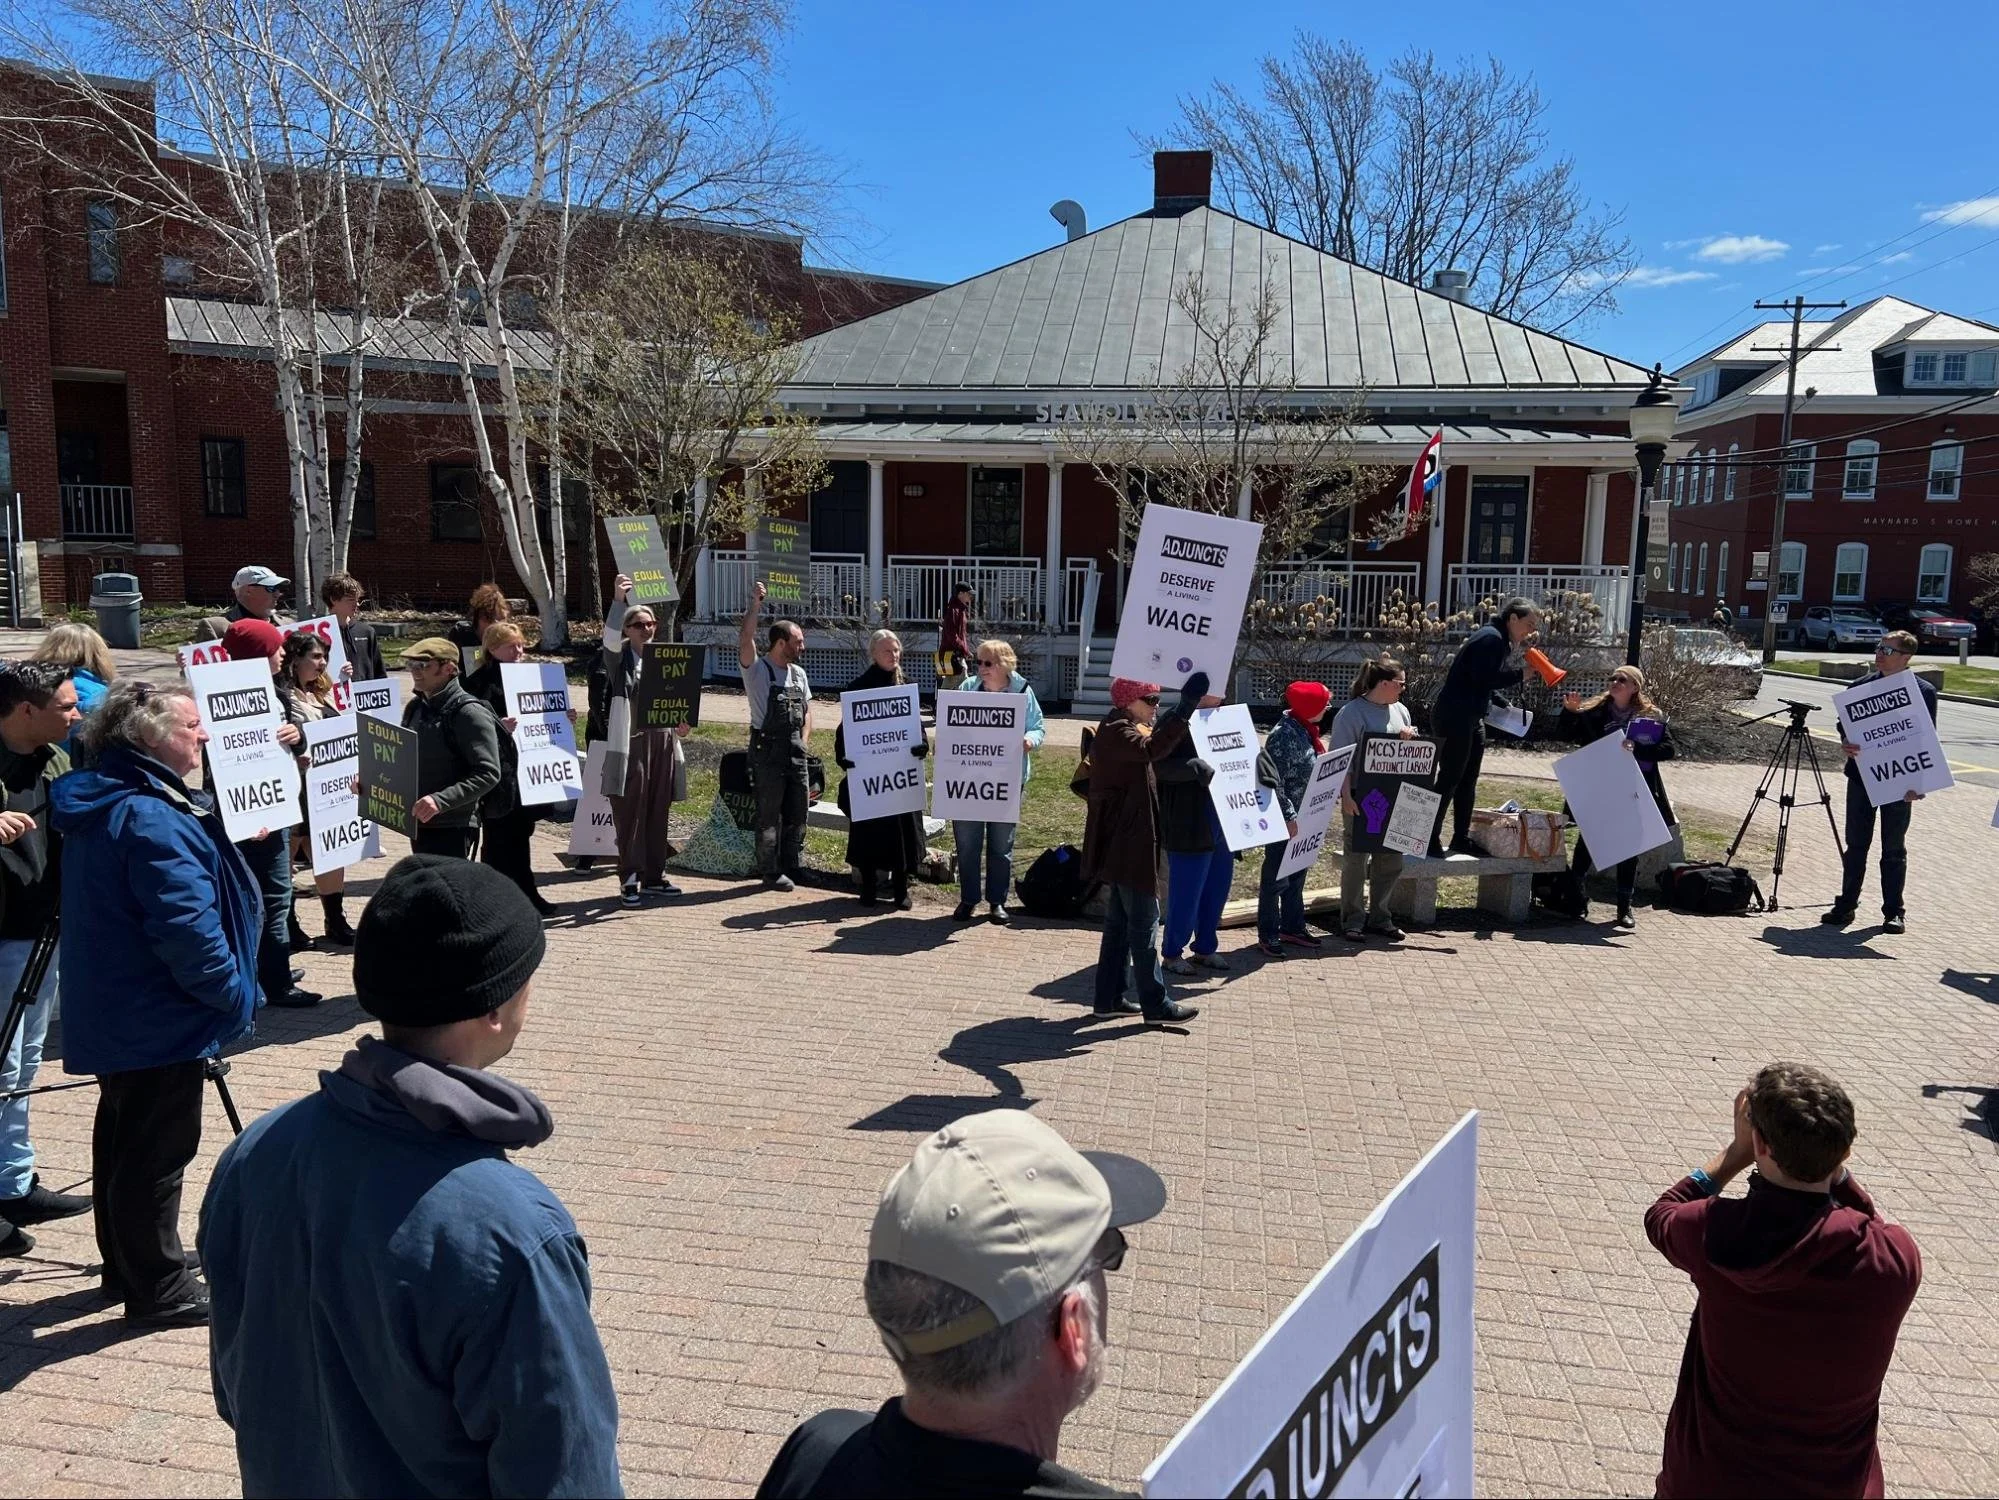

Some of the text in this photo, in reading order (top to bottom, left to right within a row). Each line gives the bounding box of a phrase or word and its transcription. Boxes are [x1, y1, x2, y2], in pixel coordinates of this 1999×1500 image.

[618, 521, 649, 533] EQUAL
[769, 522, 799, 536] EQUAL
[628, 534, 649, 555] PAY
[773, 538, 793, 553] PAY
[1161, 538, 1227, 566] ADJUNCTS
[633, 569, 665, 582] EQUAL
[769, 571, 800, 585] EQUAL
[1160, 571, 1215, 592] DESERVE
[635, 581, 671, 599] WORK
[767, 583, 801, 601] WORK
[1174, 591, 1200, 601] LIVING
[1147, 605, 1212, 636] WAGE
[654, 647, 691, 659] EQUAL
[662, 661, 687, 679] PAY
[212, 690, 267, 719] ADJUNCTS
[356, 691, 390, 709] UNCTS
[521, 693, 565, 712] ADJUNCTS
[653, 698, 690, 709] EQUAL
[1850, 690, 1909, 719] ADJUNCTS
[647, 709, 689, 724] WORK
[855, 699, 909, 720] ADJUNCTS
[950, 709, 1013, 726] ADJUNCTS
[223, 728, 270, 750] DESERVE
[367, 721, 403, 745] EQUAL
[524, 723, 562, 737] DESERVE
[862, 730, 908, 746] DESERVE
[1863, 718, 1914, 742] DESERVE
[878, 746, 899, 754] LIVING
[1367, 741, 1396, 757] MCCS
[1883, 735, 1907, 747] LIVING
[243, 751, 264, 761] LIVING
[373, 742, 396, 763] PAY
[952, 744, 1004, 757] DESERVE
[527, 760, 573, 786] WAGE
[1219, 759, 1250, 773] DESERVE
[1369, 760, 1403, 773] ADJUNCT
[1870, 751, 1934, 782] WAGE
[863, 768, 919, 796] WAGE
[946, 780, 1009, 801] WAGE
[227, 778, 286, 813] WAGE
[371, 784, 405, 809] EQUAL
[724, 792, 757, 810] EQUA
[1225, 790, 1264, 810] WAGE
[1310, 788, 1336, 808] DESERVE
[368, 797, 406, 830] WORK
[591, 812, 613, 827] WA
[321, 818, 371, 852] WAGE
[1291, 832, 1323, 860] WAGE
